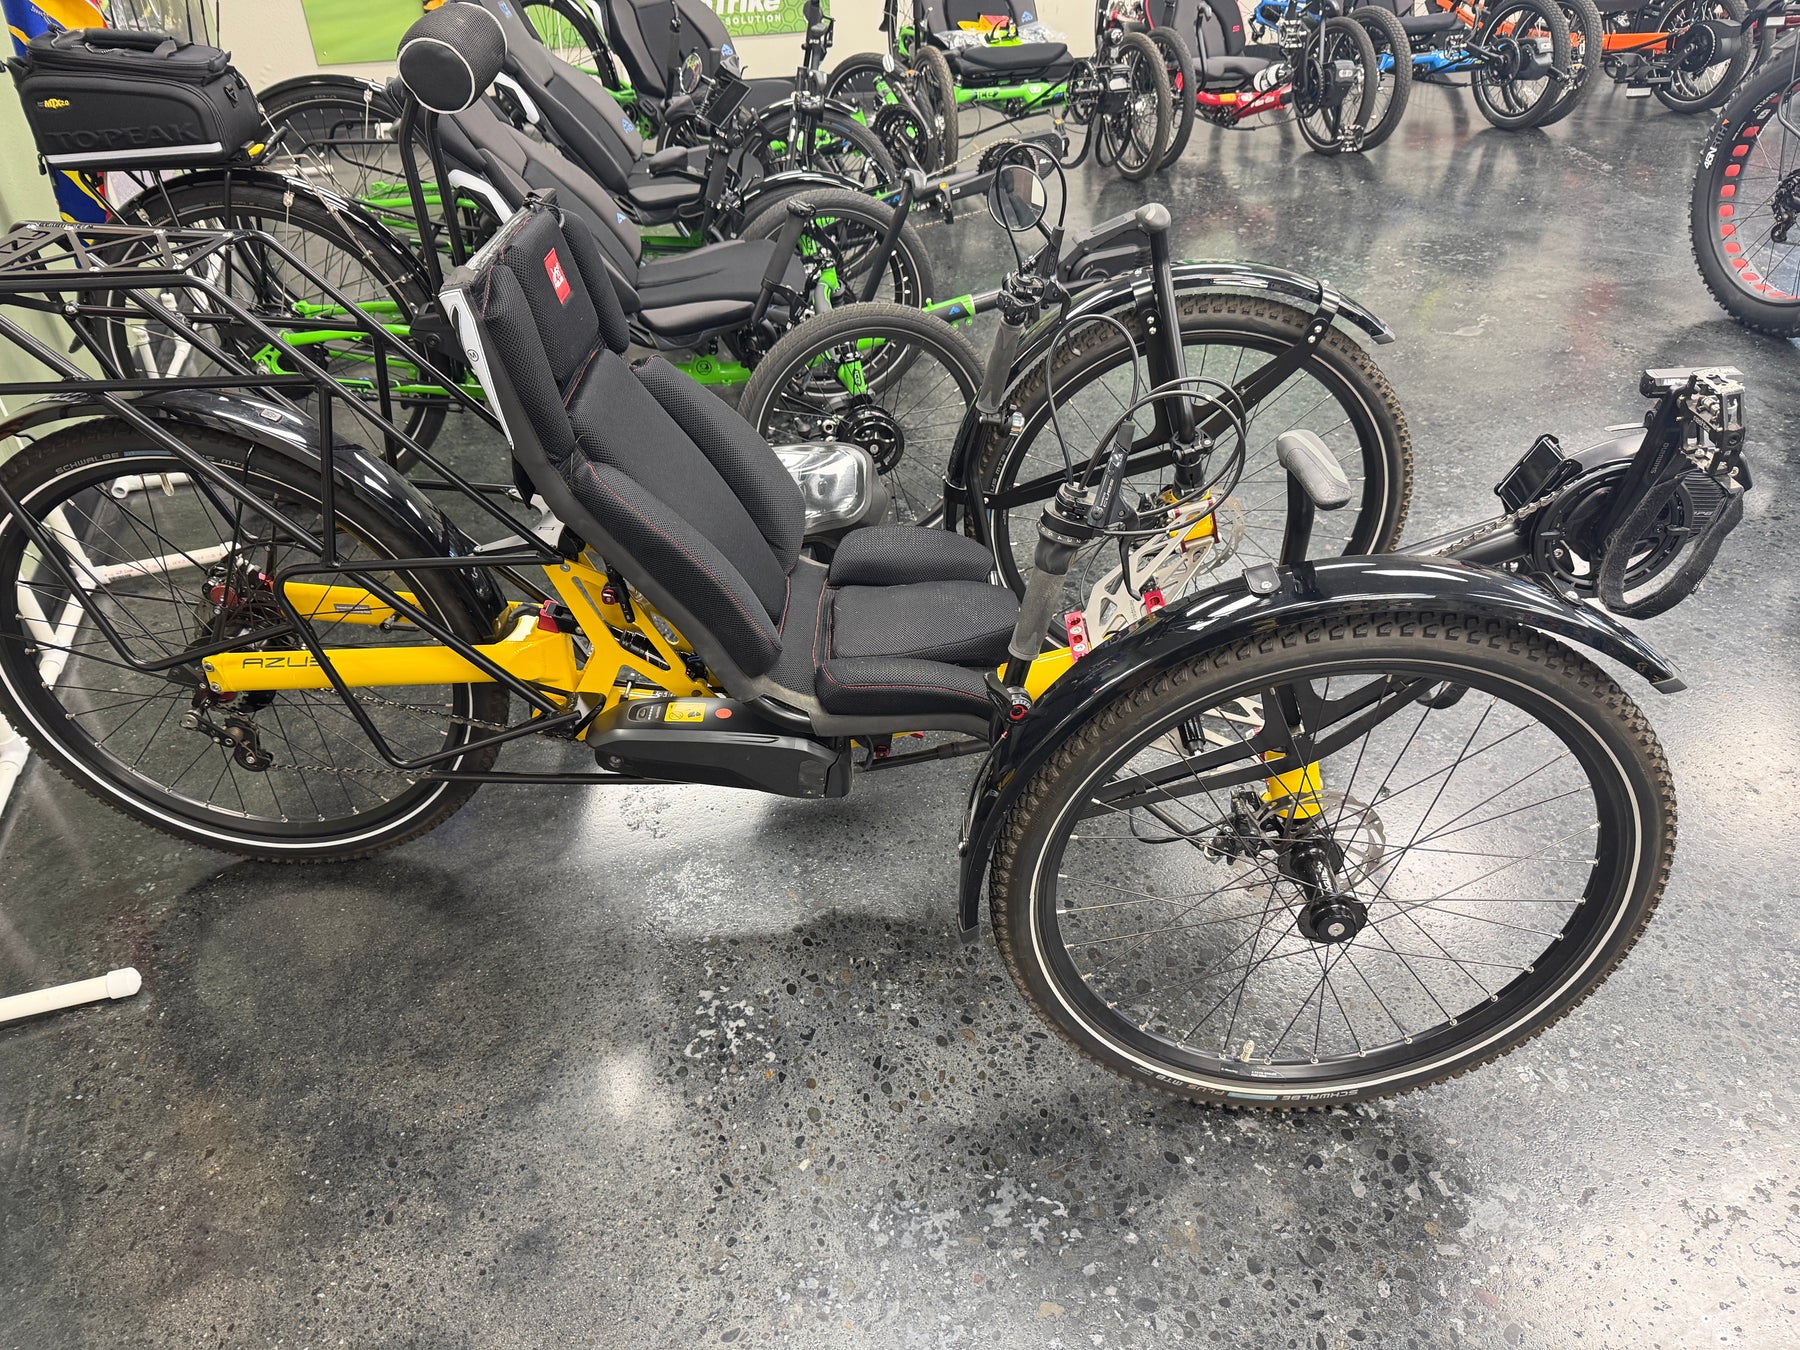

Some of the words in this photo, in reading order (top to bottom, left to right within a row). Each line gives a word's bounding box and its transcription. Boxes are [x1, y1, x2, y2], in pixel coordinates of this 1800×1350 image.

[725, 13, 781, 25] SOLUTION
[44, 122, 201, 150] TOPEAK
[55, 452, 120, 475] SCHWALBE
[1155, 1073, 1184, 1087] MTB
[1186, 1084, 1225, 1097] PLUS
[1281, 1088, 1359, 1101] SCHWALBE
